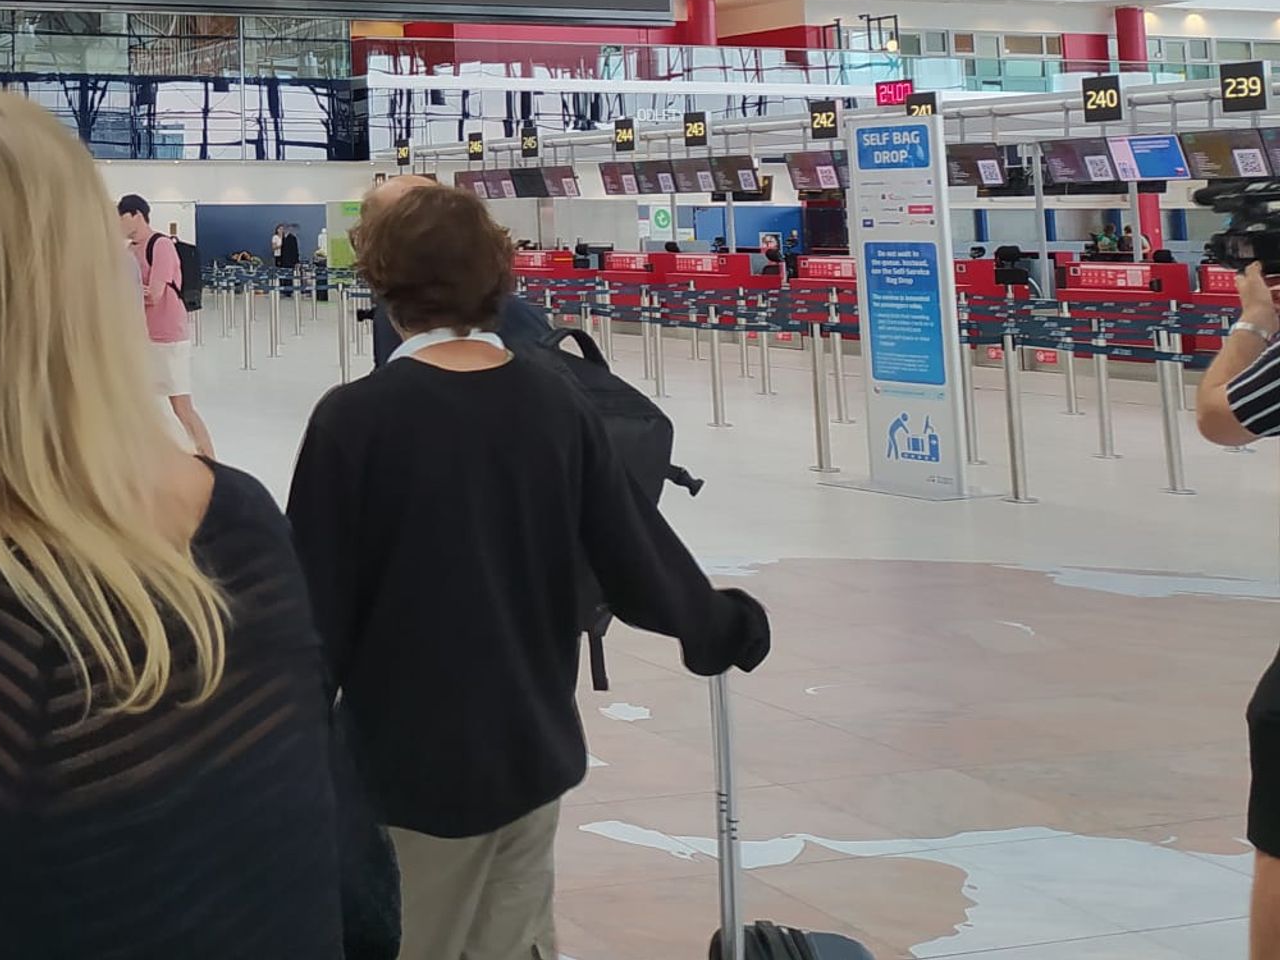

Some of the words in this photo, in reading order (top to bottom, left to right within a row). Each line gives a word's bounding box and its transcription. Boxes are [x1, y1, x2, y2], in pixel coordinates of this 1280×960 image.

[1223, 76, 1261, 98] 239
[1086, 89, 1118, 109] 240
[910, 104, 932, 116] 241
[812, 112, 835, 129] 242
[615, 128, 633, 143] 244
[685, 121, 705, 137] 243
[522, 136, 537, 149] 245
[862, 132, 889, 146] SELF
[892, 131, 920, 144] BAG
[873, 150, 908, 164] DROP
